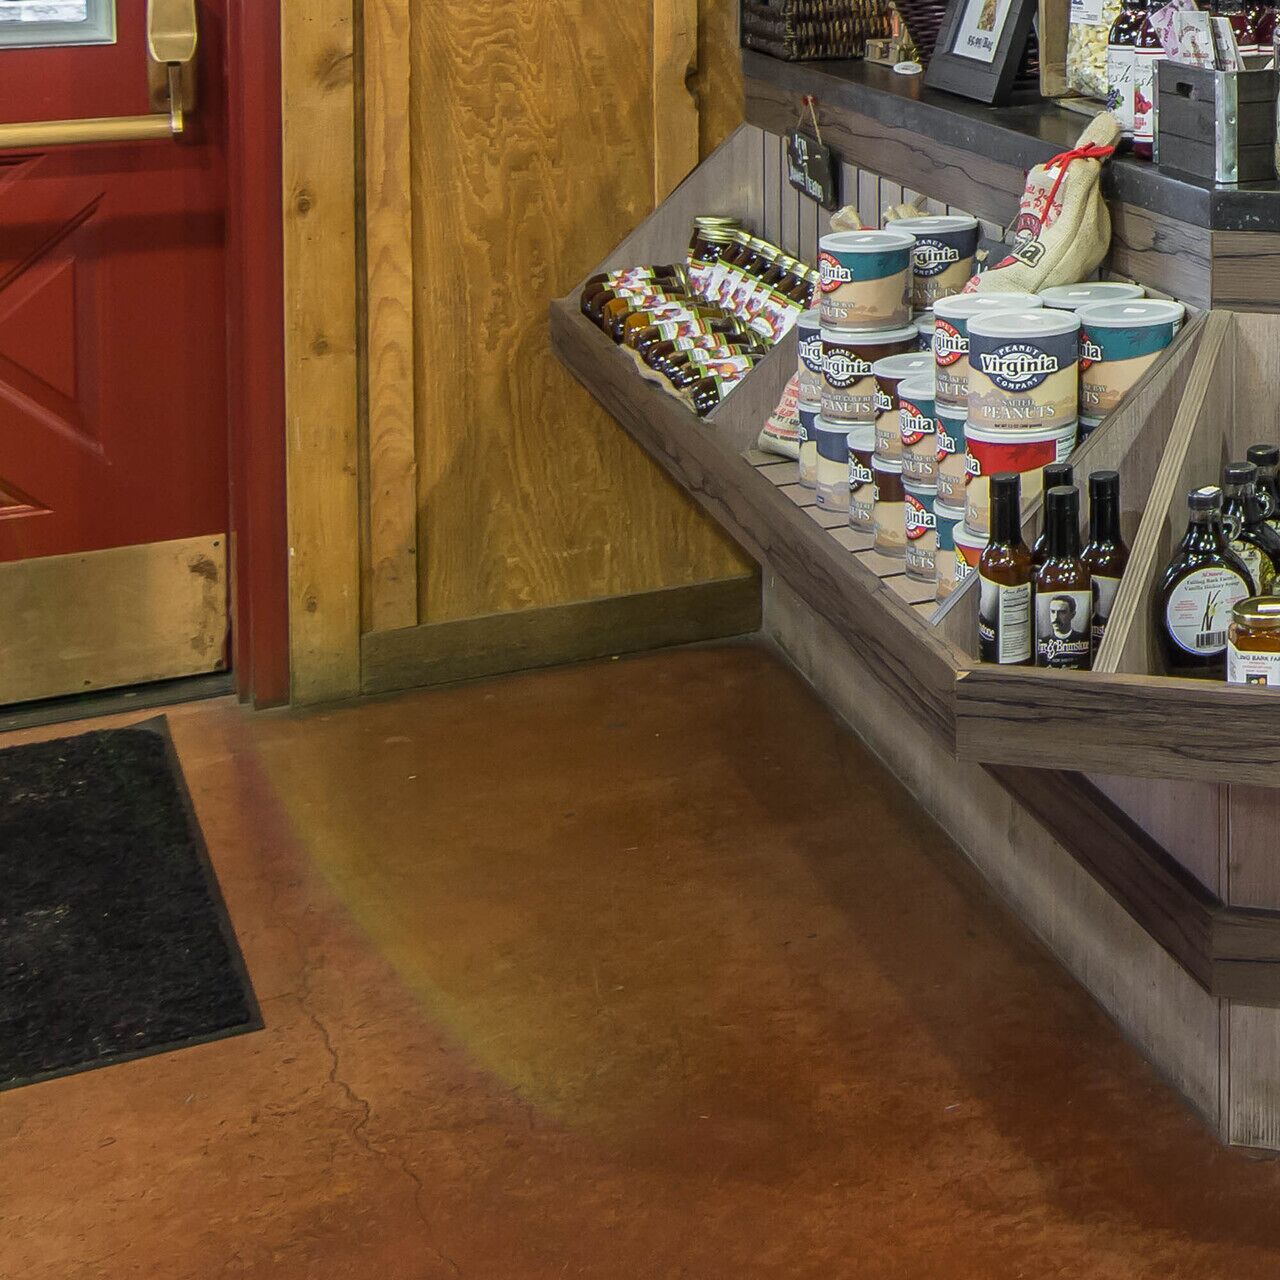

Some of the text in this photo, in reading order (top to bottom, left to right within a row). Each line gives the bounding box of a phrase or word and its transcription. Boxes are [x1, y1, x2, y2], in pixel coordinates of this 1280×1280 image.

[998, 345, 1039, 356] PEANUT
[983, 355, 1056, 376] Virginia
[996, 376, 1038, 390] COMPANY
[983, 405, 1055, 419] PEANUTS
